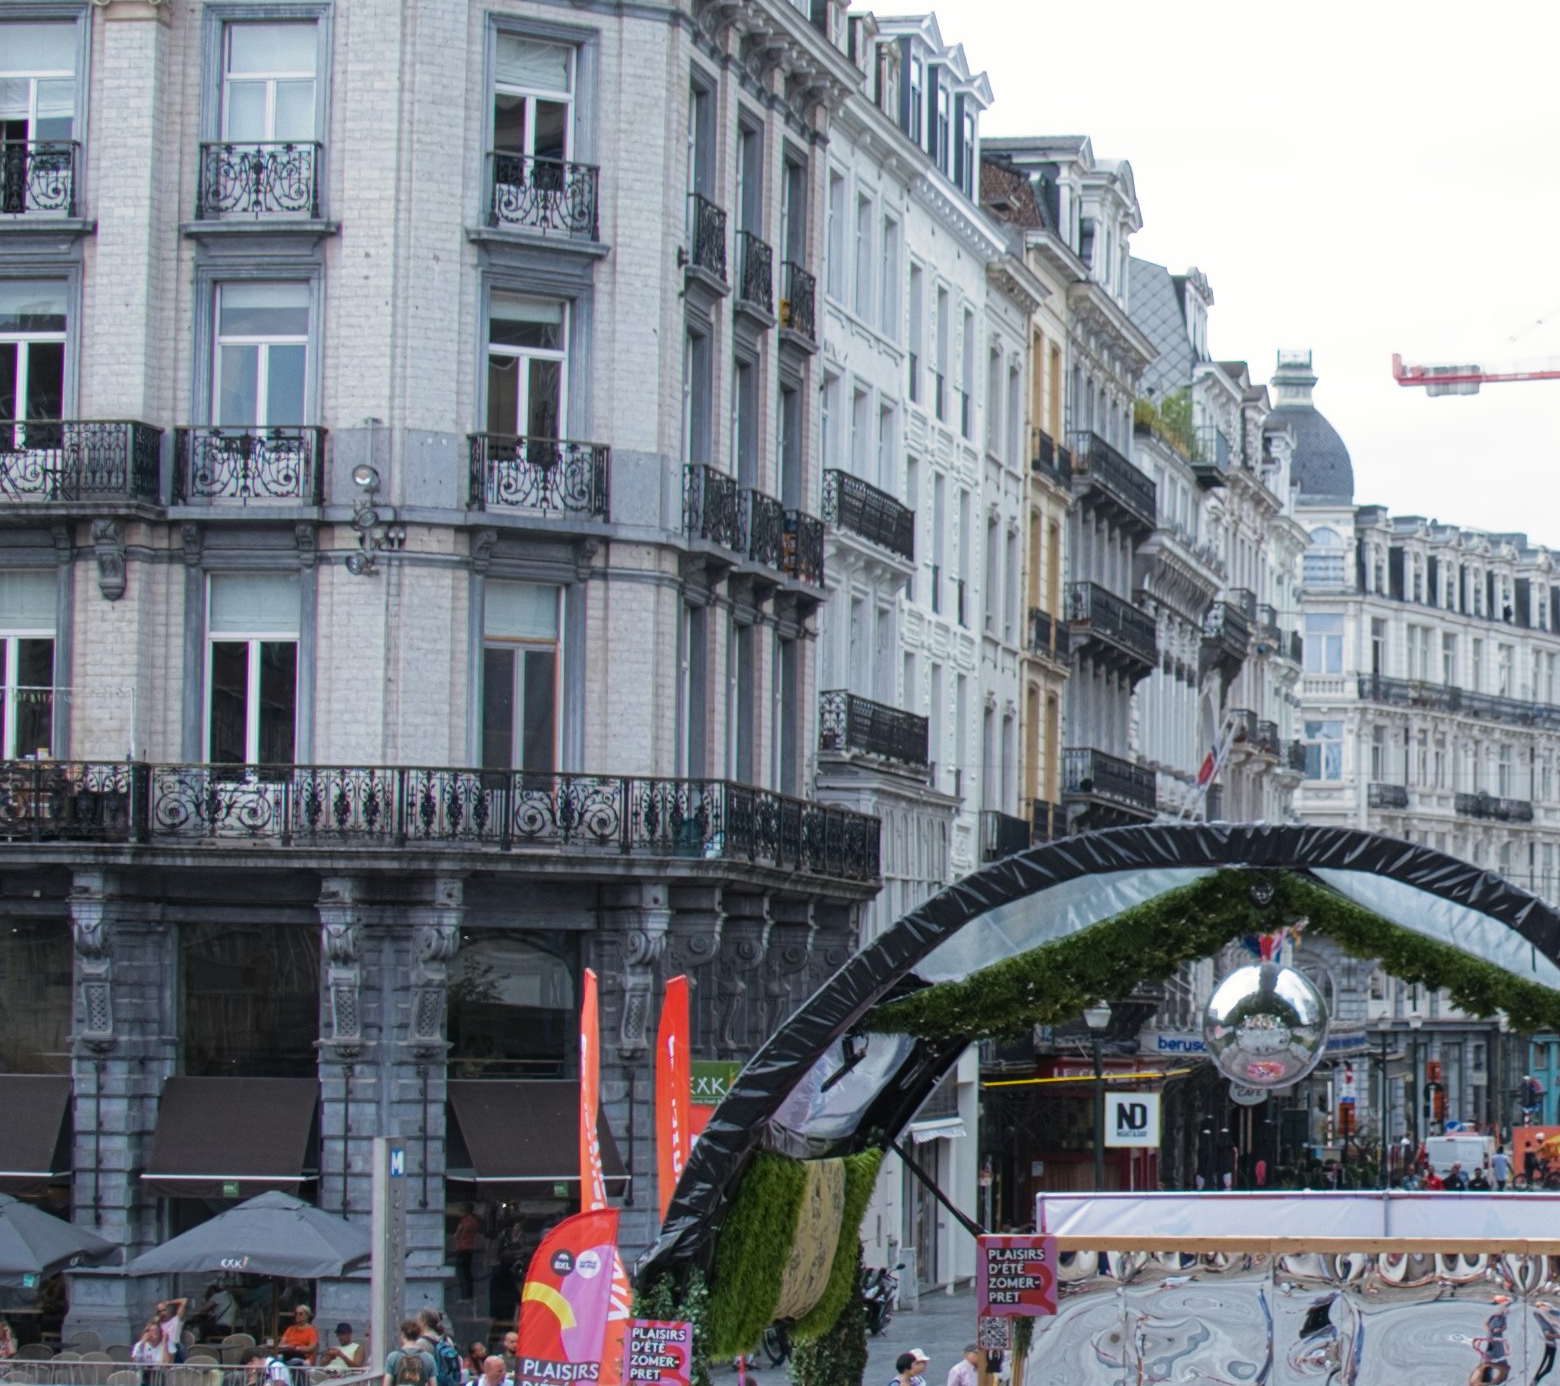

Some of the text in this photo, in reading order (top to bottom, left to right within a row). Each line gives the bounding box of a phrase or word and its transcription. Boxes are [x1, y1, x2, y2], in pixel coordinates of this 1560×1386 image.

[1117, 1103, 1147, 1129] ND
[391, 1151, 404, 1175] M
[988, 1249, 1045, 1260] PLAISIRS
[988, 1261, 1025, 1274] D'ÉTÉ
[988, 1277, 1041, 1288] ZOMER-
[988, 1292, 1020, 1303] PRET
[632, 1327, 686, 1341] PLAISIRS
[631, 1341, 666, 1354] D'ÉTÉ
[630, 1355, 680, 1368] ZOMER-
[523, 1359, 600, 1380] PLAISIRS
[630, 1369, 661, 1381] PRET
